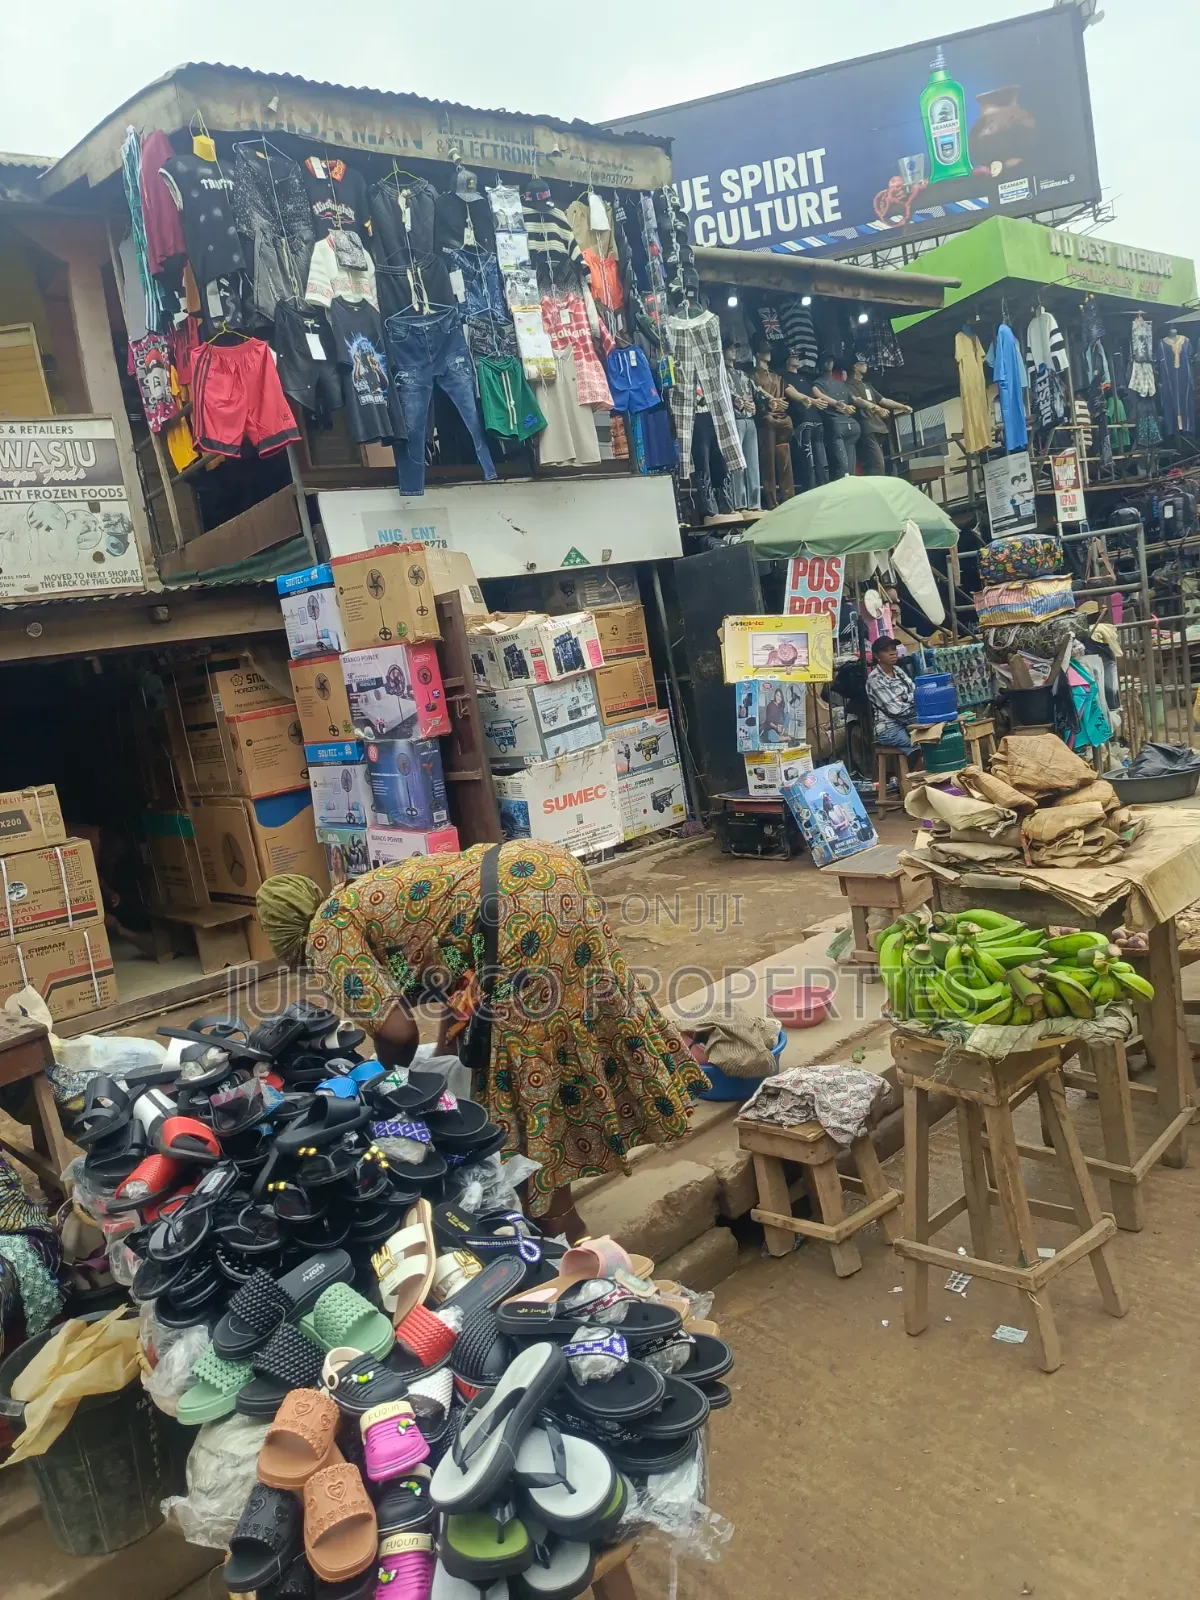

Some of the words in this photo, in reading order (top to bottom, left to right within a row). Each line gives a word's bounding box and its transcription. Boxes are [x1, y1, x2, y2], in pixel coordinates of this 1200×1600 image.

[720, 147, 827, 204] SPIRIT
[694, 185, 842, 249] CULTURE
[1078, 240, 1112, 266] BEST
[1116, 248, 1173, 278] INTERIOR
[1036, 369, 1051, 426] DIESEL
[8, 425, 16, 434] &
[20, 425, 74, 435] RETAILERS
[40, 465, 87, 485] Foods
[27, 488, 77, 500] FROZEN
[81, 487, 123, 498] FOODS
[377, 528, 407, 542] NIG.
[411, 526, 440, 540] ENT.
[43, 572, 72, 582] MOVED
[74, 572, 85, 580] TO
[86, 571, 106, 580] NEXT
[108, 570, 128, 578] SHOP
[130, 569, 139, 577] AT
[58, 580, 77, 588] BACK
[91, 578, 109, 586] THIS
[110, 576, 143, 584] COMPLEX
[791, 556, 841, 592] POS
[542, 783, 607, 815] SUMEC
[27, 941, 65, 955] FIRMAN
[36, 950, 51, 958] NEW
[385, 1536, 420, 1551] FUQUN
